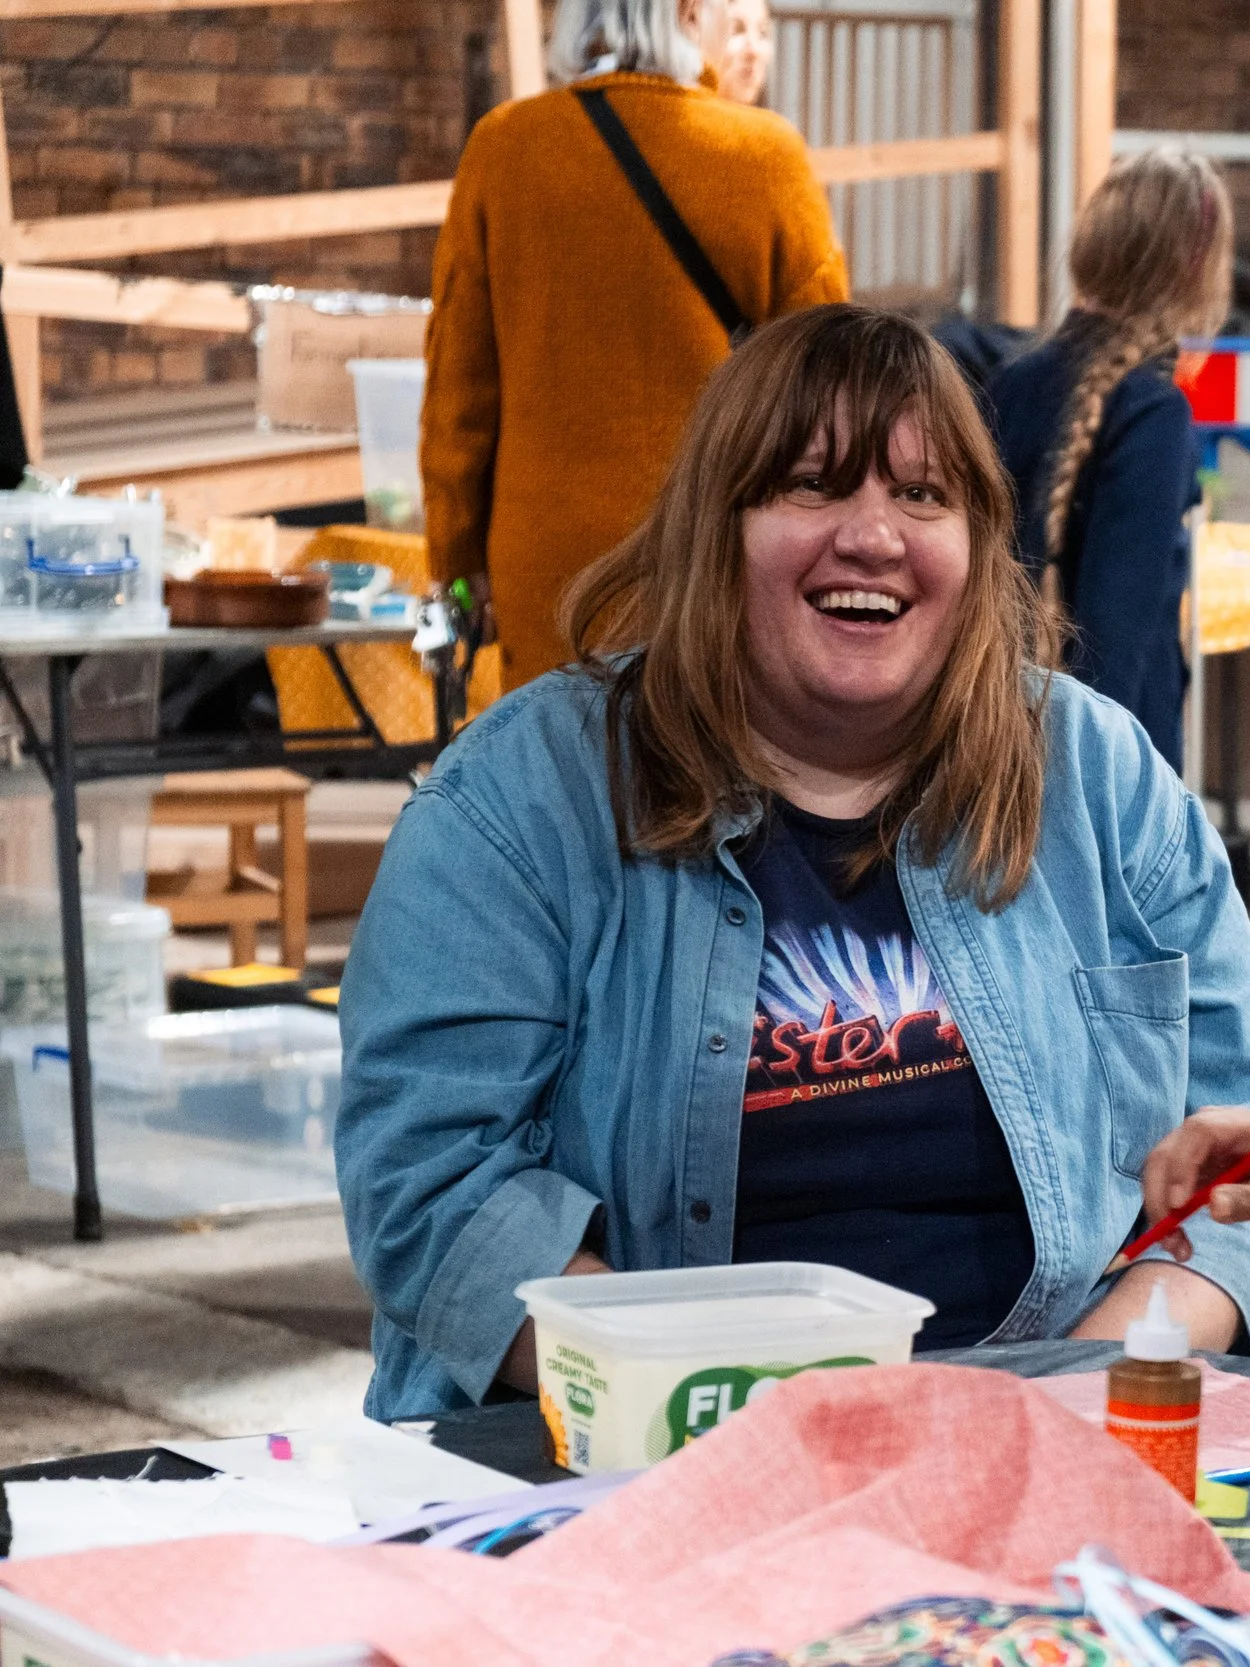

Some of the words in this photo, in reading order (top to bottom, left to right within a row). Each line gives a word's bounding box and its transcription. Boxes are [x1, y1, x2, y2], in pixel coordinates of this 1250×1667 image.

[791, 1088, 803, 1099] A
[810, 1075, 871, 1096] DIVINE
[878, 1060, 950, 1083] MUSICAL
[546, 1357, 582, 1382] CREAMY
[585, 1373, 609, 1396] TASTE
[556, 1344, 596, 1372] ORIGINAL
